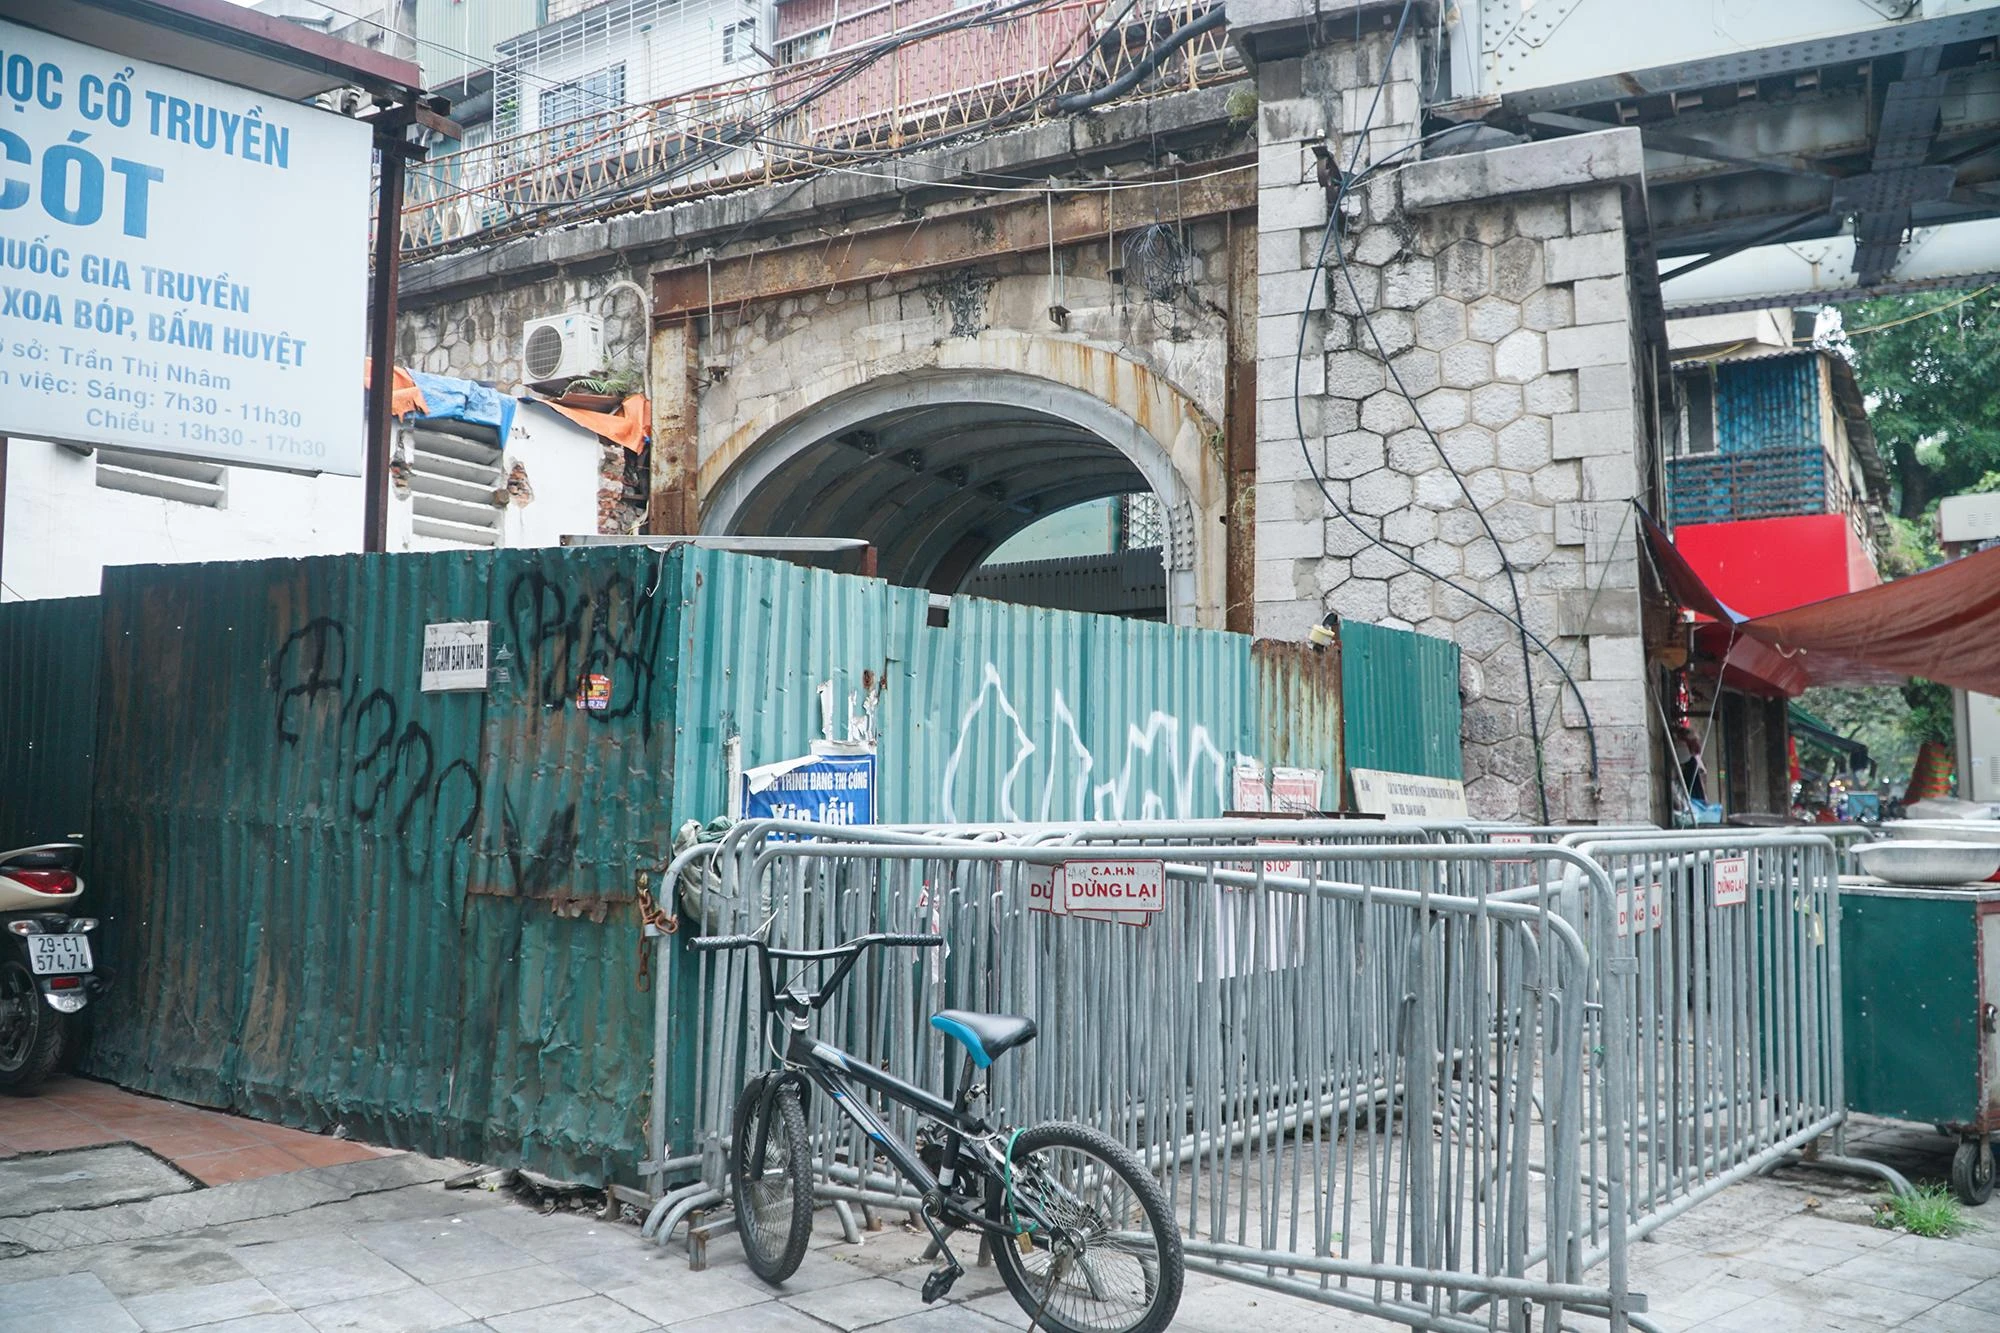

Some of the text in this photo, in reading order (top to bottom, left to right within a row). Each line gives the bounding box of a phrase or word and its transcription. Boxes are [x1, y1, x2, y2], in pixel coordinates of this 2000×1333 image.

[0, 53, 289, 169] ỌC CỔ TRUYỀN
[0, 235, 250, 313] UỐC GIA TRUYỀN
[2, 286, 306, 370] XOA BÓP, BẤM HUYỆT
[12, 338, 49, 361] sở:
[59, 345, 113, 371] Trần
[122, 356, 158, 382] Thị
[167, 364, 231, 390] Nhâm
[19, 370, 77, 395] việc:
[87, 379, 155, 409] Sáng:
[164, 391, 217, 416] 7h30
[240, 402, 301, 428] 11h30
[86, 408, 155, 434] Chiều
[179, 421, 244, 447] 13h30
[265, 431, 327, 458] 17h30
[1072, 878, 1157, 902] DỪNG LẠI
[1091, 866, 1135, 876] C.A.H.N
[1266, 859, 1291, 872] STOP
[36, 953, 88, 971] 574.74
[38, 937, 80, 953] 29-C1
